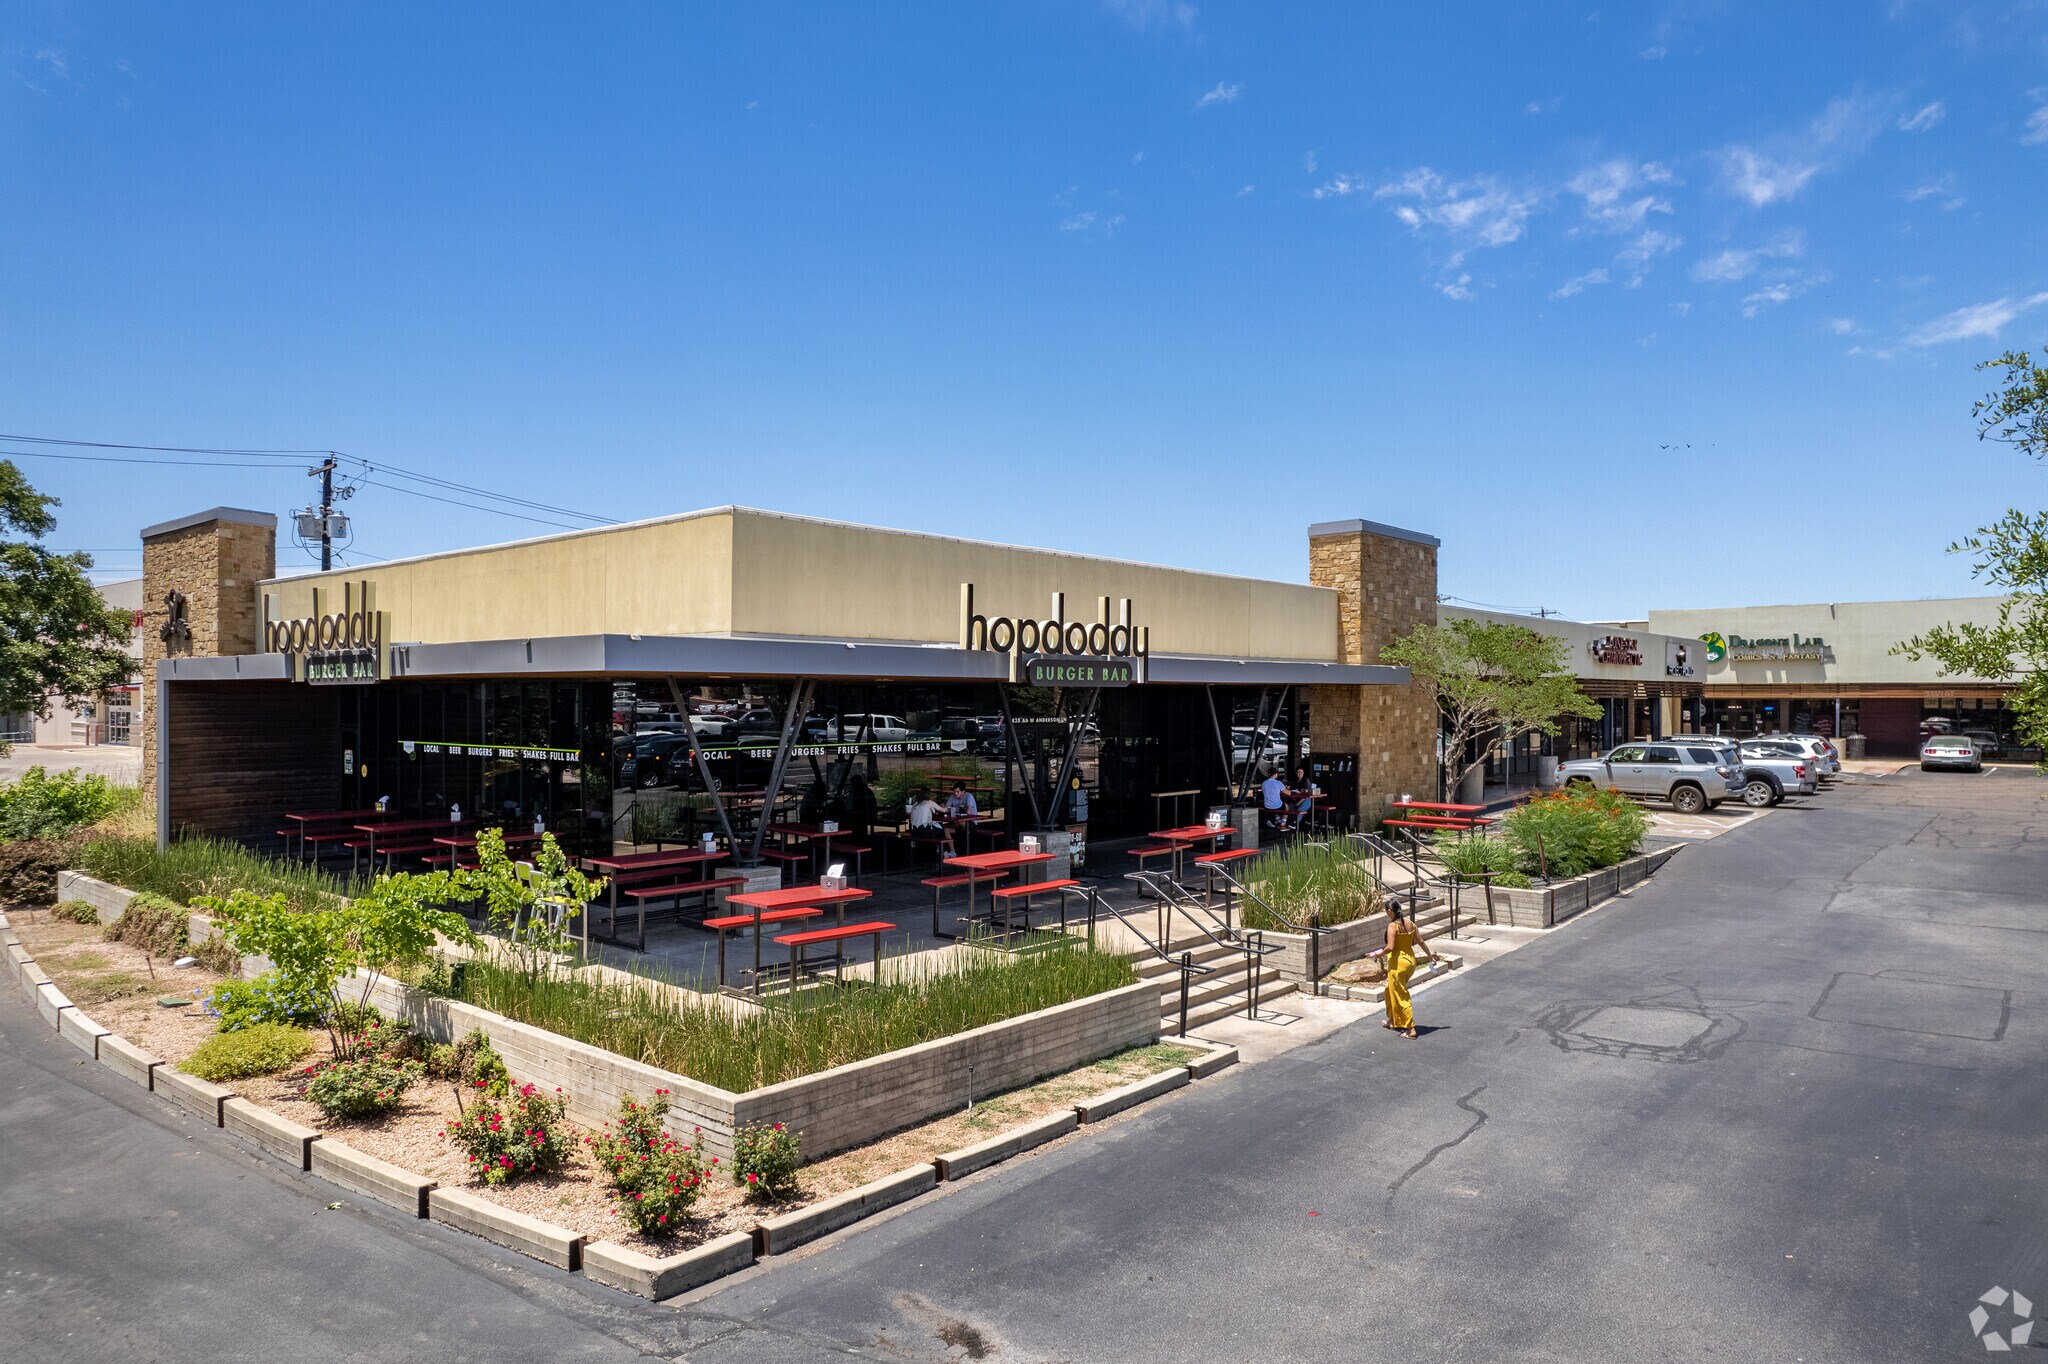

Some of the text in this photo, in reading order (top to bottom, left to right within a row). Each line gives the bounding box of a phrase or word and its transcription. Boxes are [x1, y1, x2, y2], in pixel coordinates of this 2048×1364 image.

[264, 580, 388, 682] hopdoddy
[959, 582, 1149, 683] hopdoddy
[309, 661, 374, 680] BURGER BAR
[1036, 665, 1128, 681] BURGER BAR
[423, 745, 440, 754] LOCAL
[449, 746, 462, 755] BEER
[468, 747, 493, 757] BURGERS
[499, 748, 514, 758] FRIES
[523, 750, 547, 760] SHAKES
[549, 751, 565, 761] FULL
[566, 752, 580, 762] BAR
[702, 750, 728, 761] OCAL
[750, 748, 772, 759] BEER
[791, 746, 825, 757] URGERS
[837, 745, 859, 755] FRIES
[872, 743, 902, 753] SHAKES
[907, 742, 924, 752] FULL
[926, 742, 941, 751] BAR
